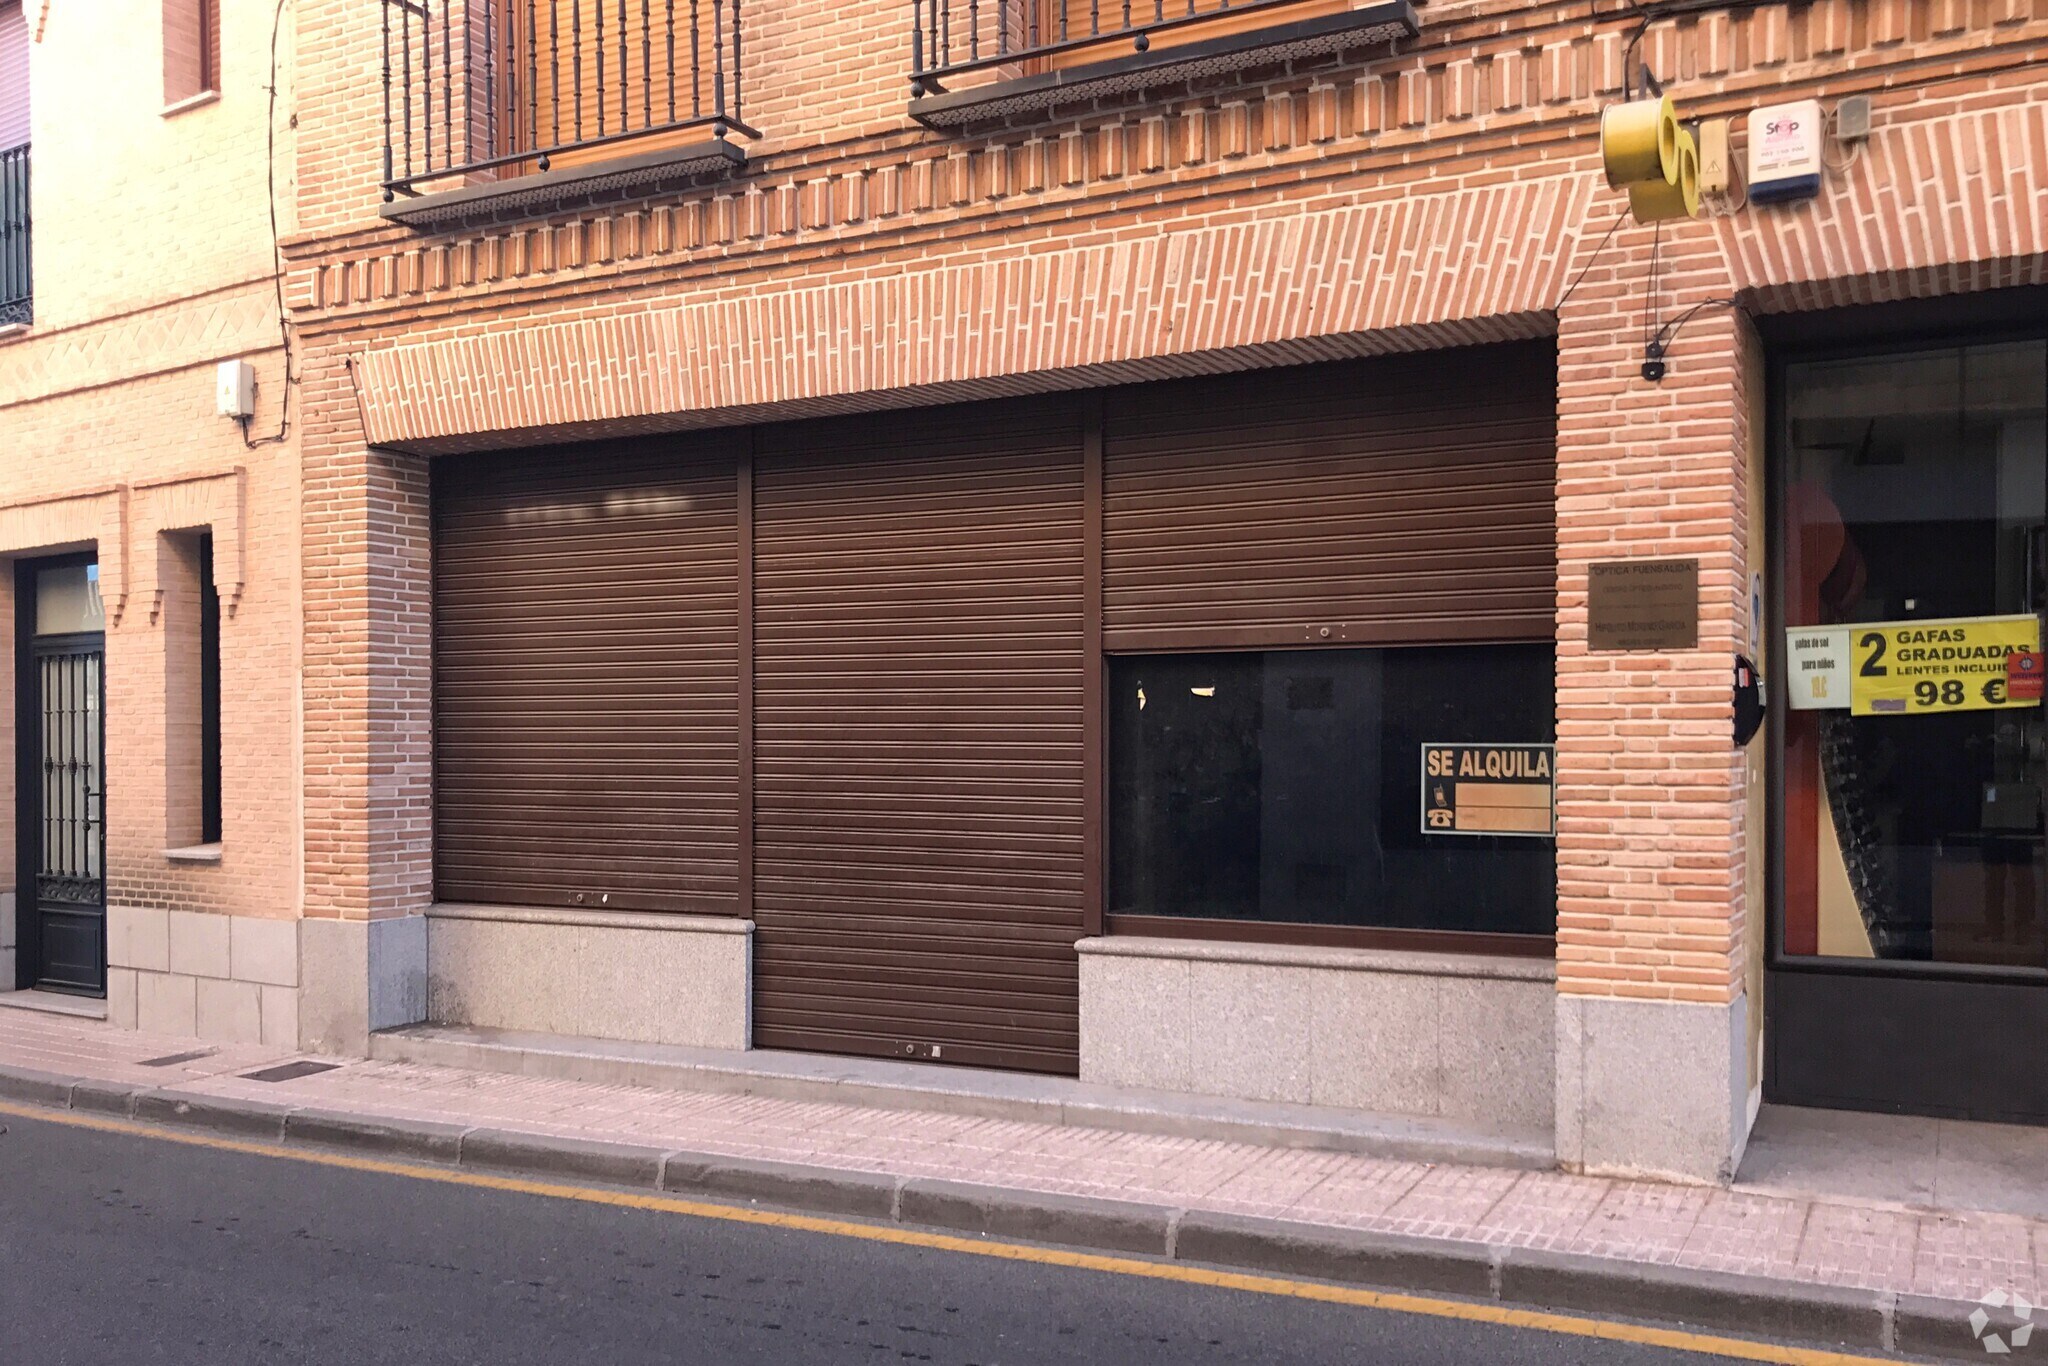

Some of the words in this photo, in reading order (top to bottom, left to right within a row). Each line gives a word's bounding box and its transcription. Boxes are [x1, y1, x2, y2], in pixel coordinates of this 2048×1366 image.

[1632, 563, 1692, 575] FUENSALIDA
[1820, 636, 1829, 647] sol
[1896, 628, 1966, 644] GAFAS
[1859, 632, 1888, 677] 2
[1896, 644, 2031, 661] GRADUADAS
[1801, 660, 1817, 671] para
[1896, 664, 1950, 676] LENTES
[1914, 679, 1965, 706] 98
[1980, 678, 2007, 704] €
[1427, 750, 1454, 777] SE
[1459, 750, 1550, 779] ALQUILA
